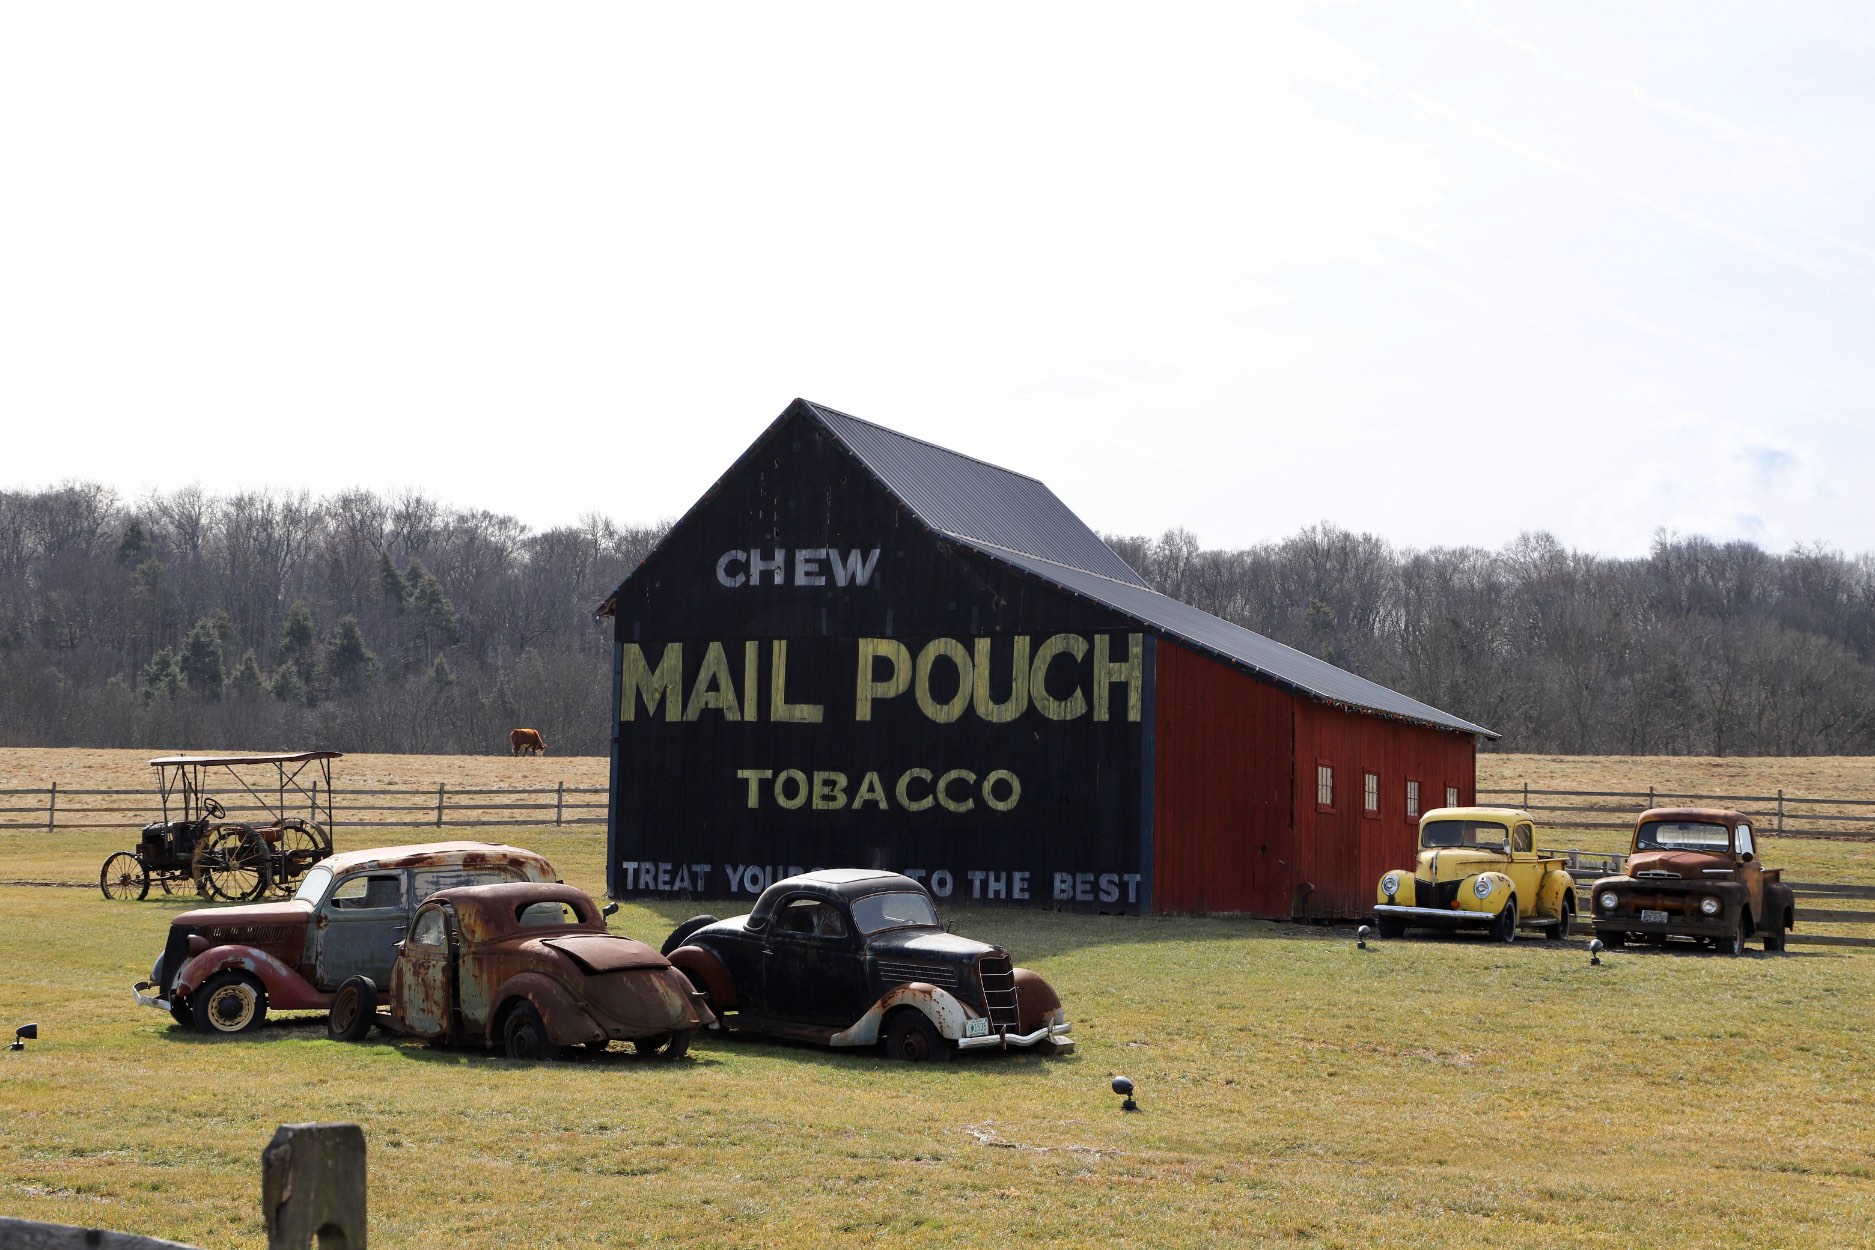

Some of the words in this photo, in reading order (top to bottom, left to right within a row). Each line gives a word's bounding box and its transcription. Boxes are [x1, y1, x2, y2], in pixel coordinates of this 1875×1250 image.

[715, 547, 881, 588] CHEW
[620, 639, 825, 723] MAIL
[855, 633, 1144, 724] POUCH
[737, 767, 1022, 812] TOBACCO
[622, 861, 712, 892] TREAT
[967, 870, 1031, 900] THE
[1053, 872, 1141, 903] BEST
